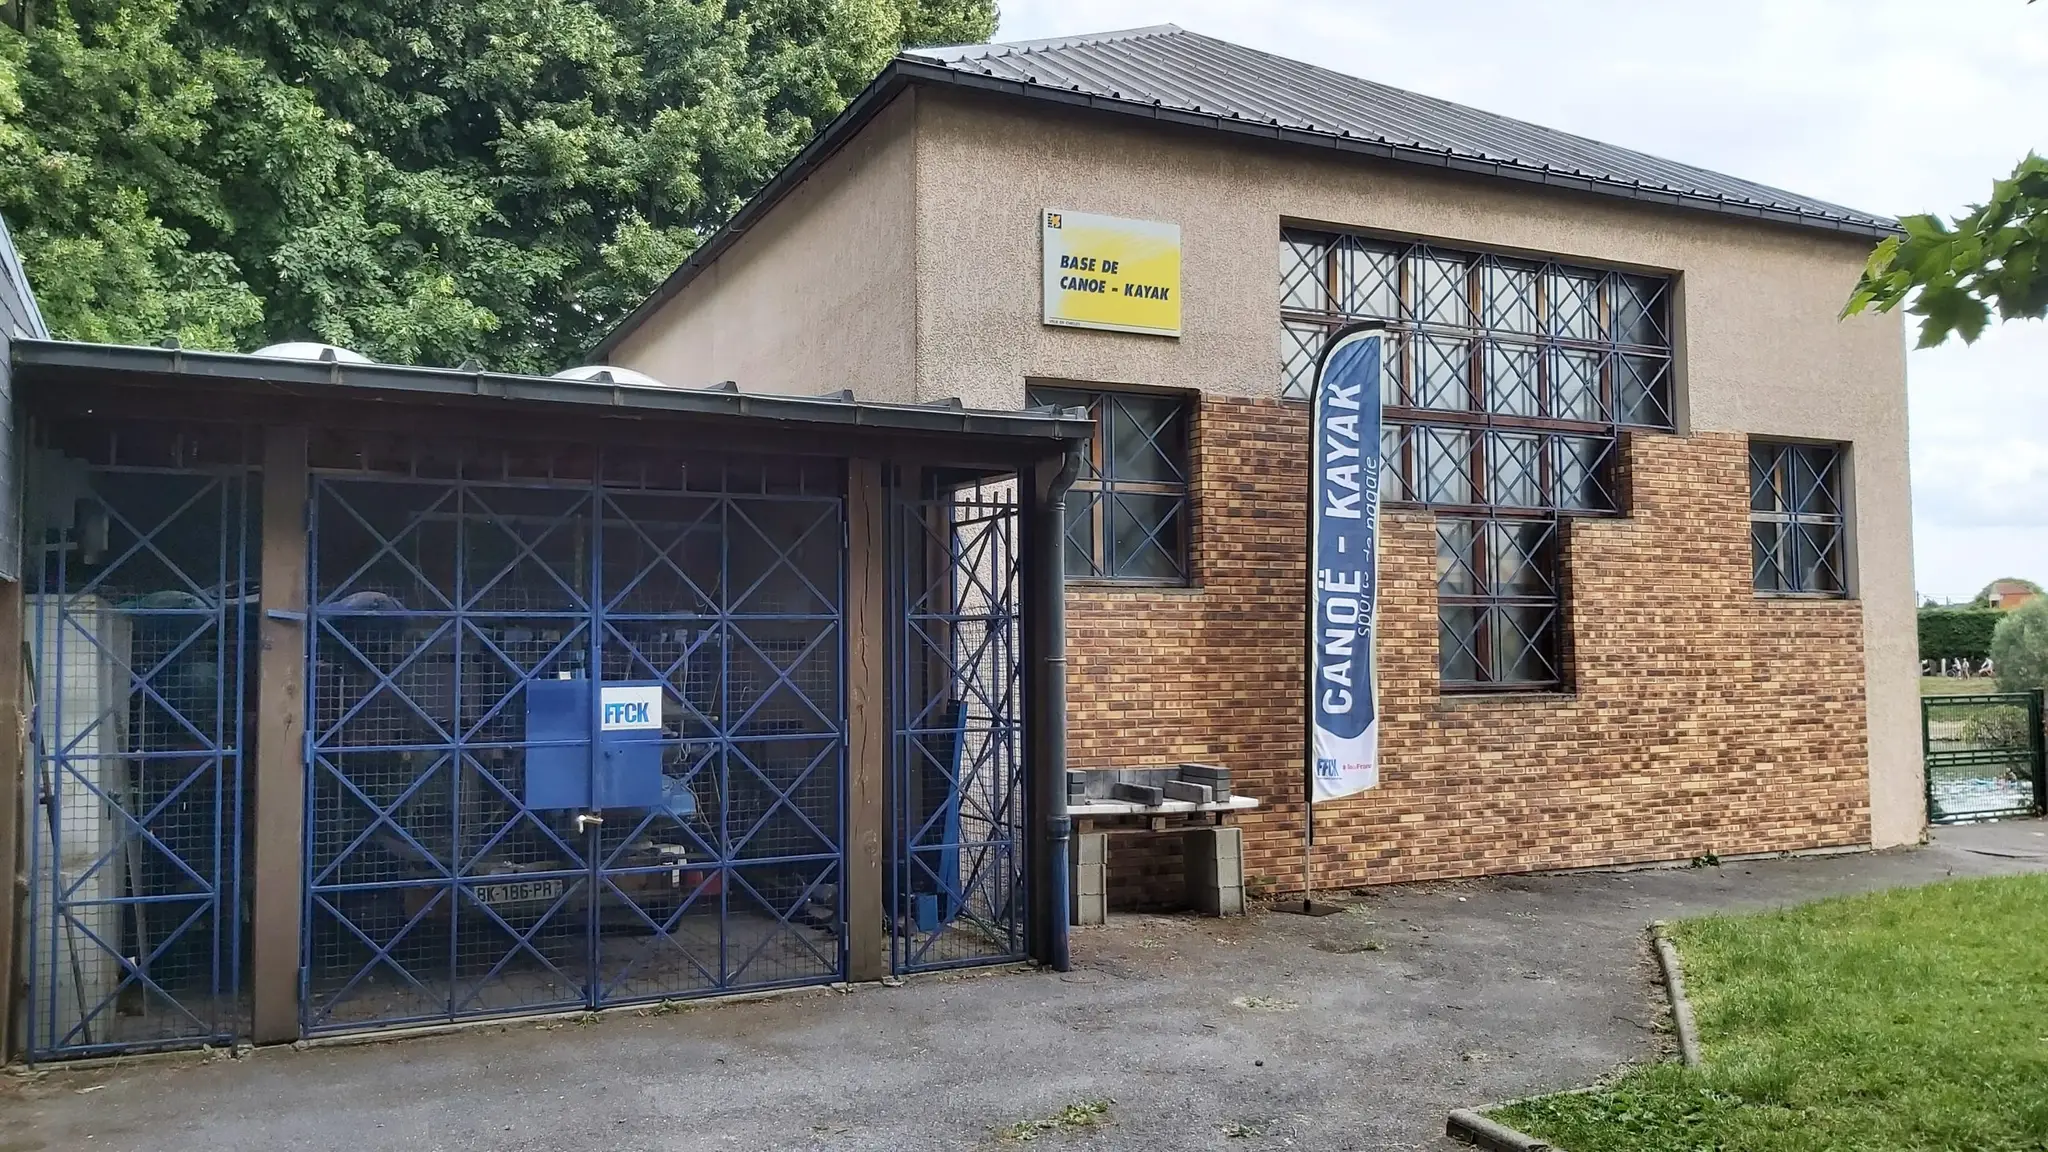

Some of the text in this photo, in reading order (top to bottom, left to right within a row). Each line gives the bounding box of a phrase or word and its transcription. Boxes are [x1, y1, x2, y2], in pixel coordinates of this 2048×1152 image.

[1060, 255, 1119, 274] BASE DE
[1060, 276, 1106, 293] CANOE
[1124, 283, 1170, 300] KAYAK
[1325, 383, 1361, 519] KAYAK
[1318, 568, 1361, 714] CANOË
[605, 702, 649, 724] FFCK
